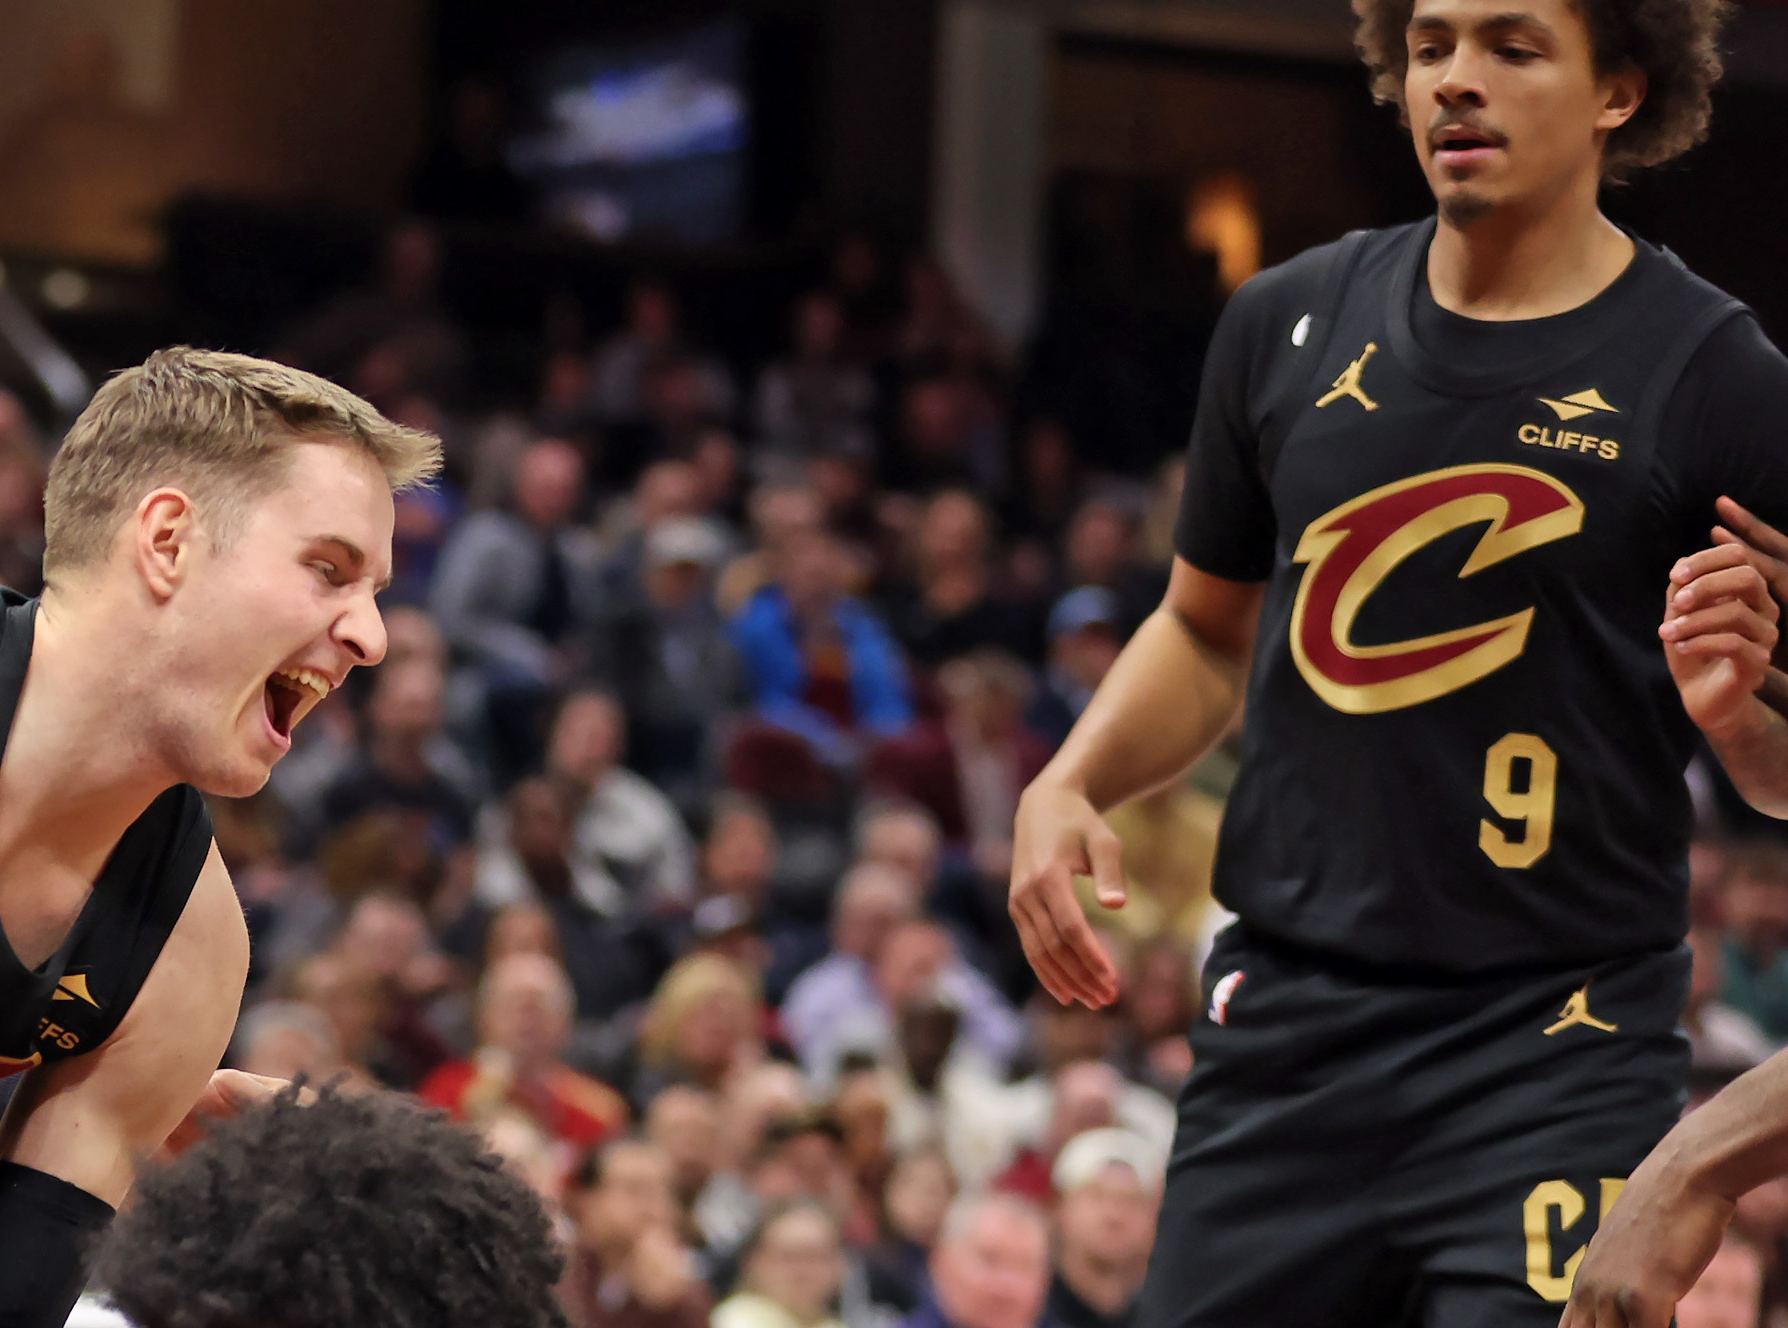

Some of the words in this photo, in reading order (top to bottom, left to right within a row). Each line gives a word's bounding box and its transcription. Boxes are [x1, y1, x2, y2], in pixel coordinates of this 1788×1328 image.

[1517, 423, 1620, 460] CLIFFS
[1289, 461, 1586, 715] C
[1478, 732, 1558, 870] 9
